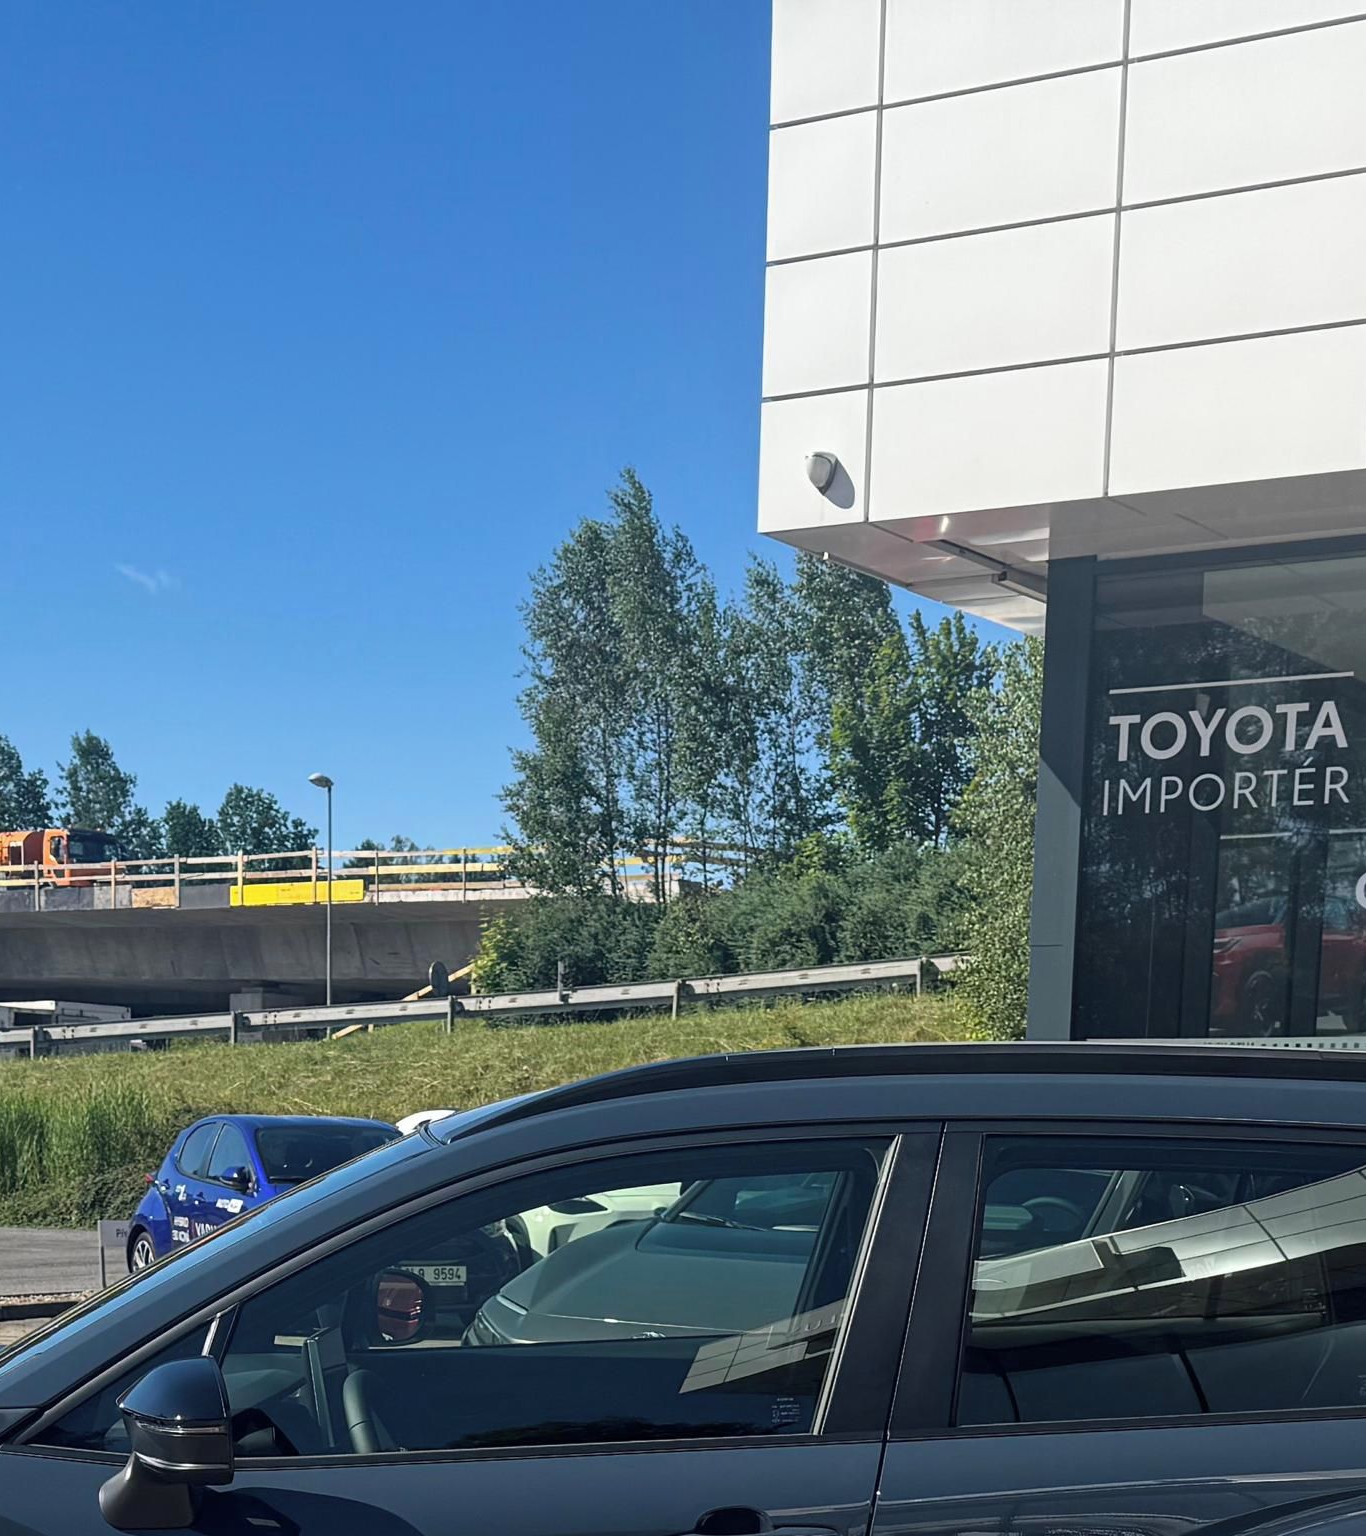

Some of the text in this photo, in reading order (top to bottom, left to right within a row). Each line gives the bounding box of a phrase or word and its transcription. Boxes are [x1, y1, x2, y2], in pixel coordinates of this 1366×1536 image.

[1108, 700, 1348, 763] TOYOTA
[1101, 756, 1351, 816] IMPORTÉR
[433, 1267, 461, 1280] 9594
